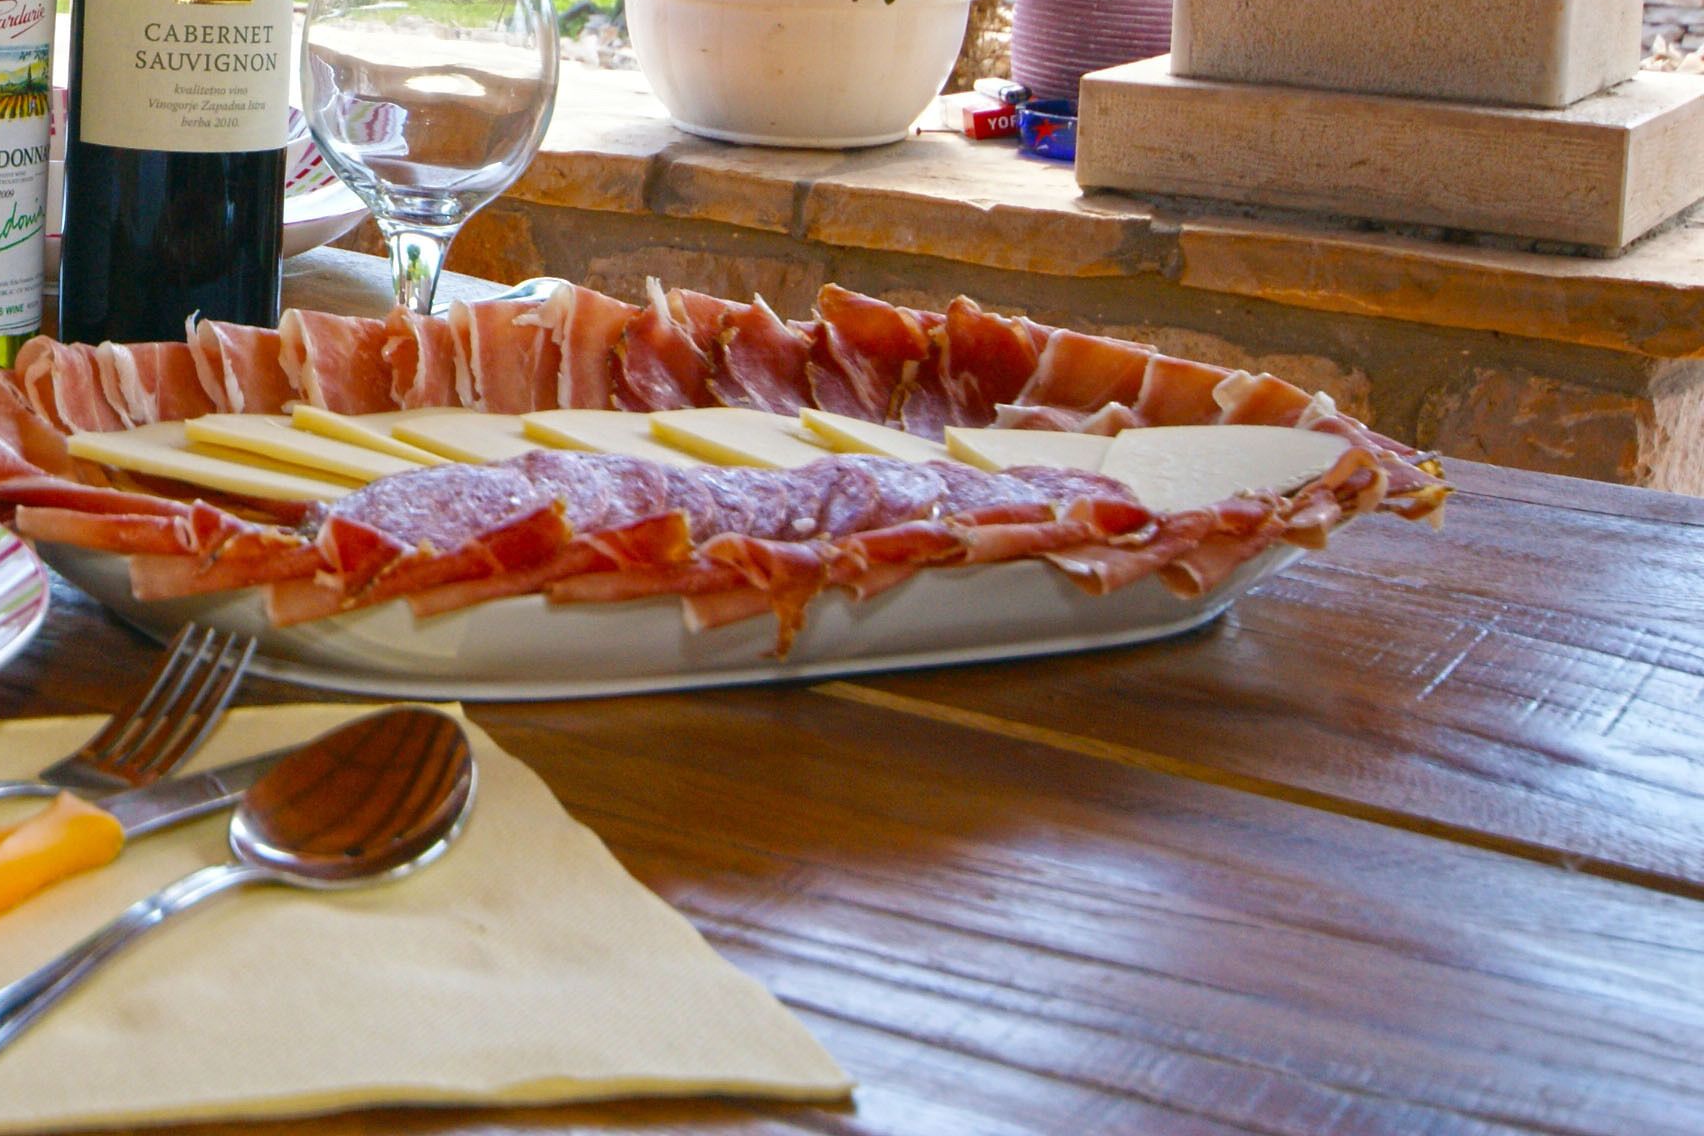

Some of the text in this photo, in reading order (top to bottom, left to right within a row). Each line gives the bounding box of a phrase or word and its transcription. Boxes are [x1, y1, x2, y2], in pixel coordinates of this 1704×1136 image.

[144, 23, 273, 45] CABERNET
[135, 50, 277, 73] SAUVIGNON
[174, 84, 248, 96] kvalitetno vino
[148, 98, 199, 113] Vinogorje
[201, 100, 245, 113] Zapadna
[181, 116, 211, 128] berba
[5, 303, 25, 316] WINE
